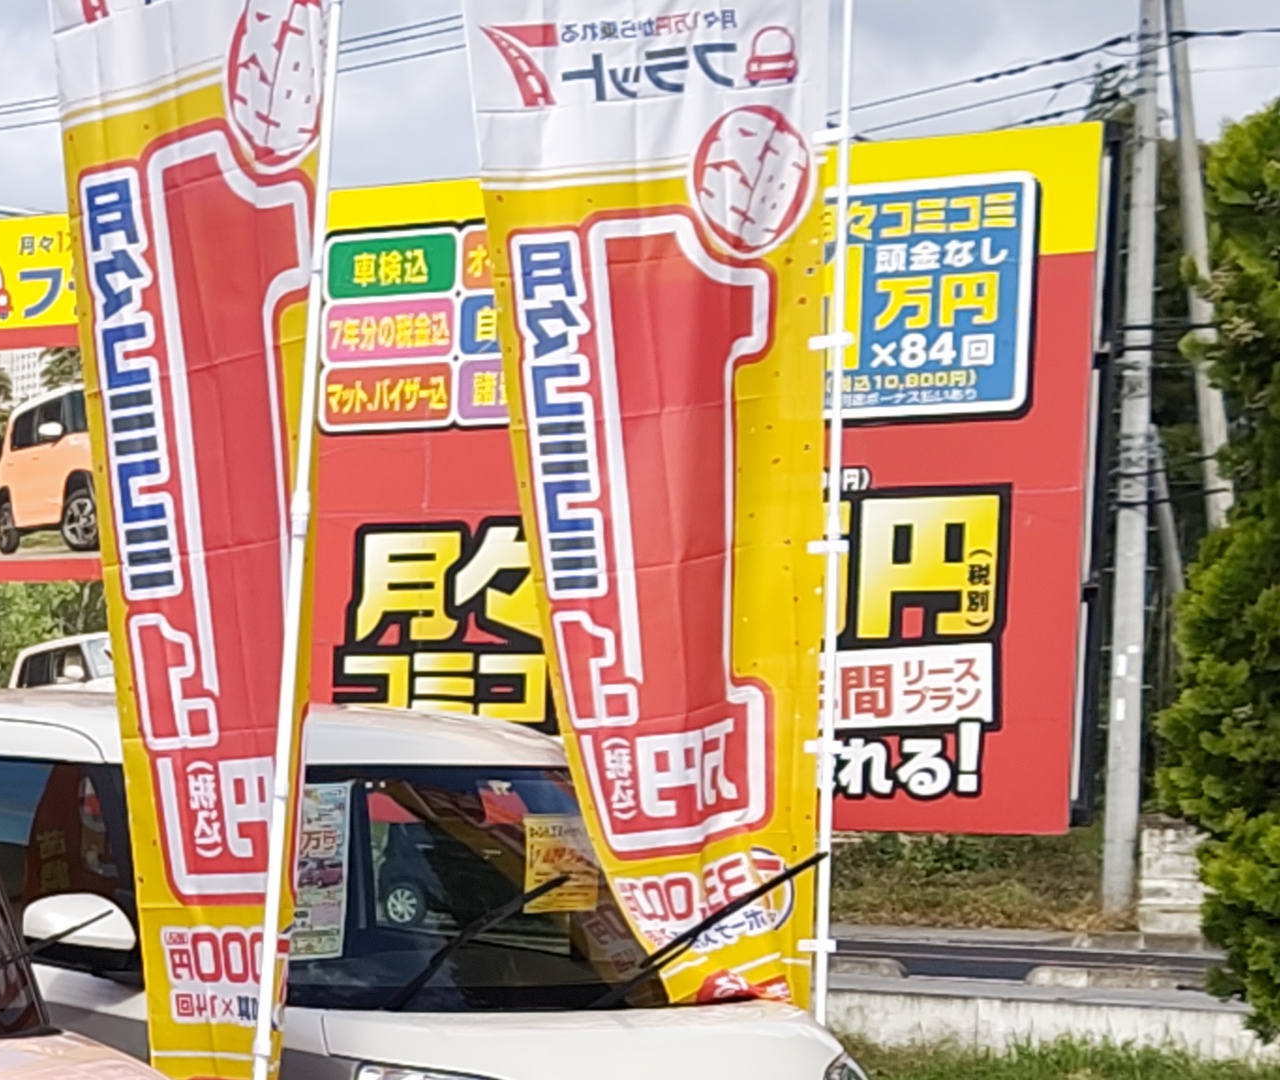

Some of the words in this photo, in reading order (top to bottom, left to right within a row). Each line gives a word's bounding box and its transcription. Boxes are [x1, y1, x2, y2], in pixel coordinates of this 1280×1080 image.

[352, 247, 429, 286] 車検込
[874, 237, 1009, 274] 頭金なし
[329, 311, 451, 352] 7年分の税金込
[903, 657, 980, 686] リース
[902, 684, 983, 714] プラン
[818, 720, 982, 796] れる!
